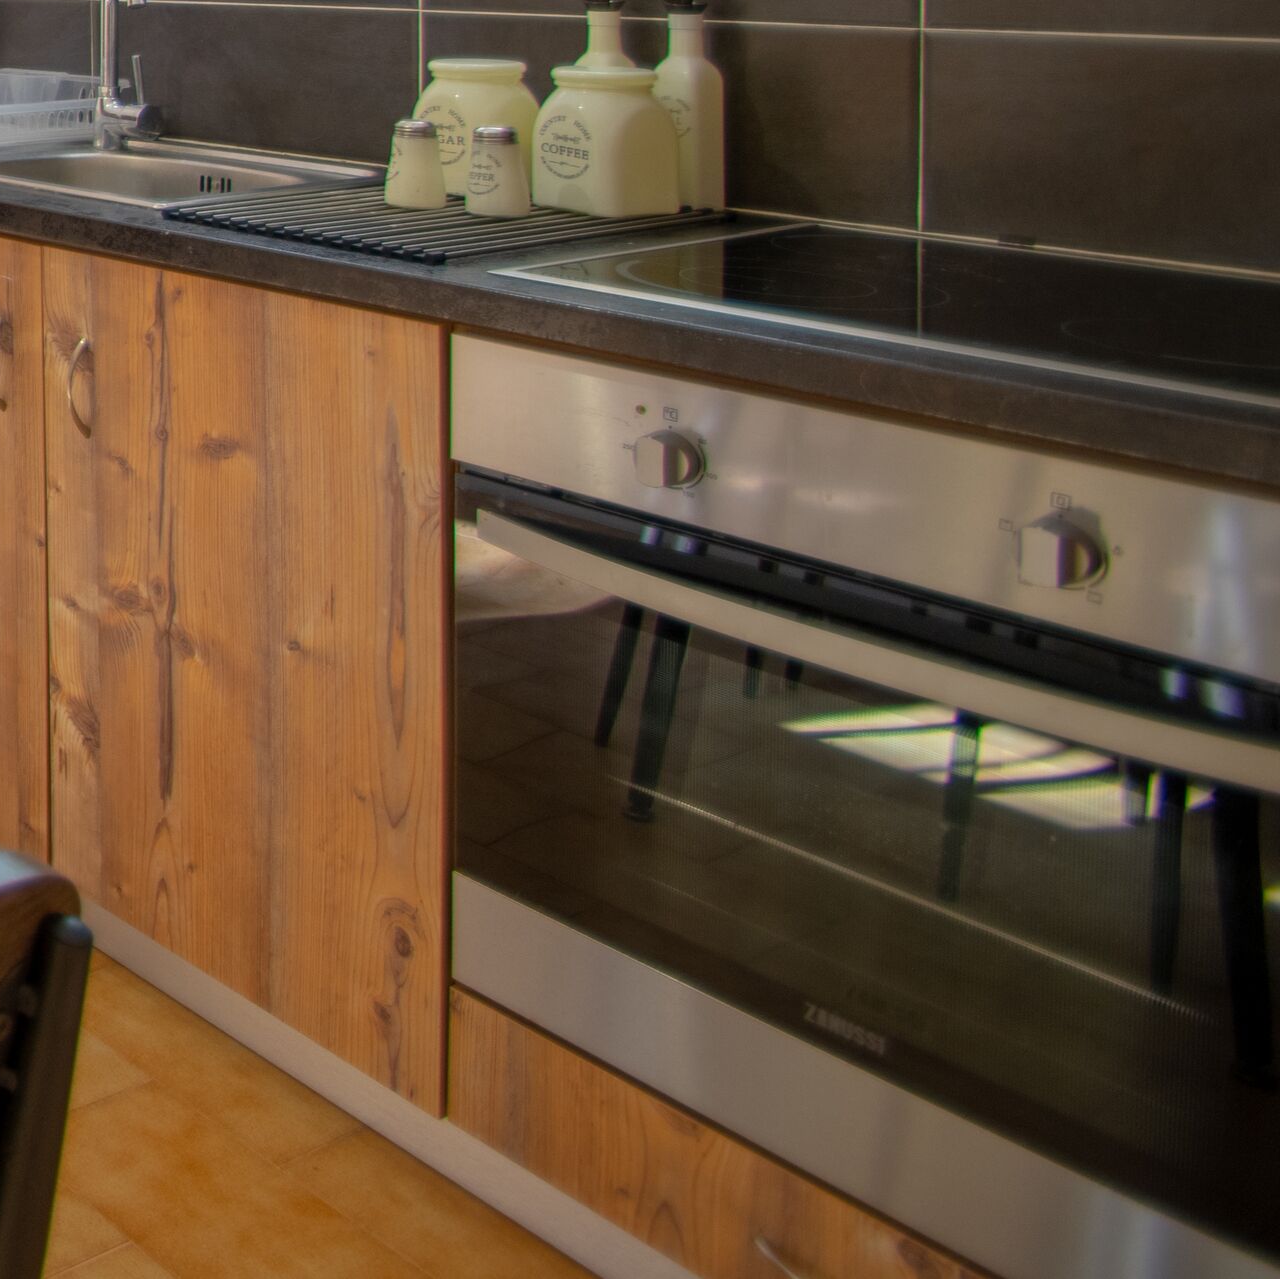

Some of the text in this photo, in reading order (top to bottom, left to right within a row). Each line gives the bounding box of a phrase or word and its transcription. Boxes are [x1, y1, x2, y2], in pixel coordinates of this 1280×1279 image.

[437, 134, 466, 146] GAR
[540, 142, 589, 161] COFFEE
[804, 1001, 884, 1055] ZANUSSI
